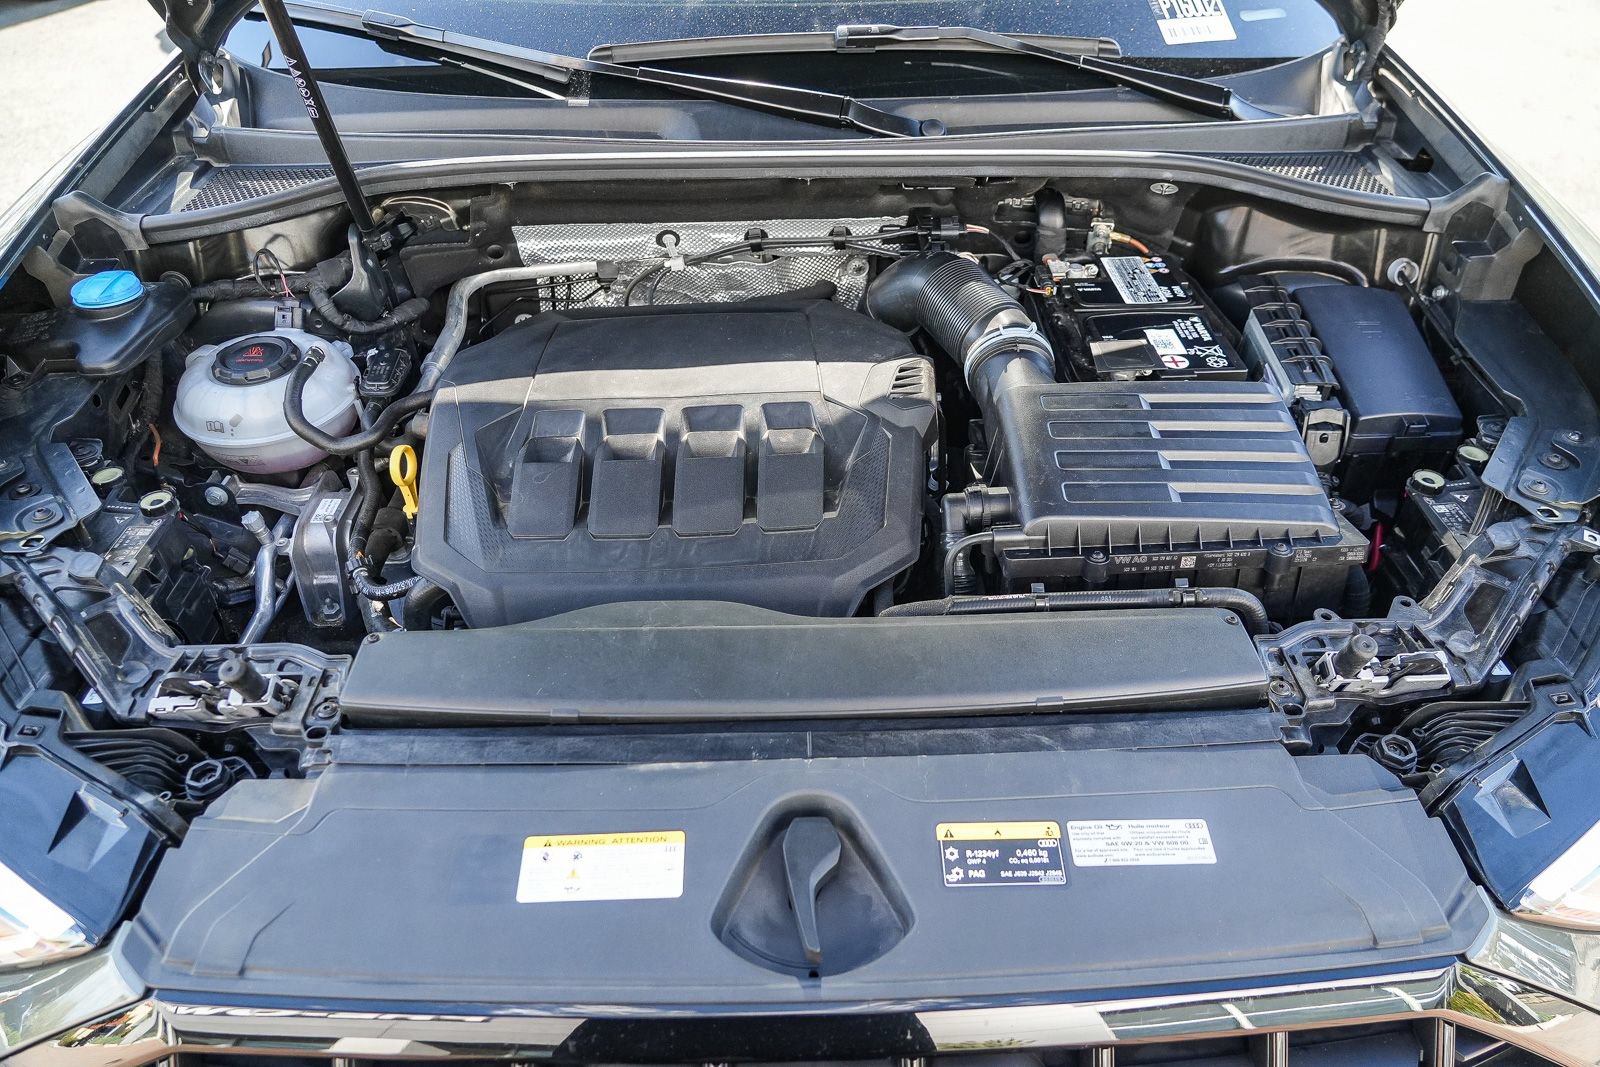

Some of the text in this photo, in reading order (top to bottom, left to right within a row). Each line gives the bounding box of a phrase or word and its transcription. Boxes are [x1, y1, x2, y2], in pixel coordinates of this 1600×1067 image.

[1114, 556, 1131, 565] VW
[1132, 555, 1148, 564] AG
[556, 836, 668, 846] WARNING ATTENTION
[966, 849, 999, 859] R-1234yf
[1038, 849, 1048, 859] kg
[968, 870, 986, 878] PAG
[1000, 870, 1013, 878] SAE
